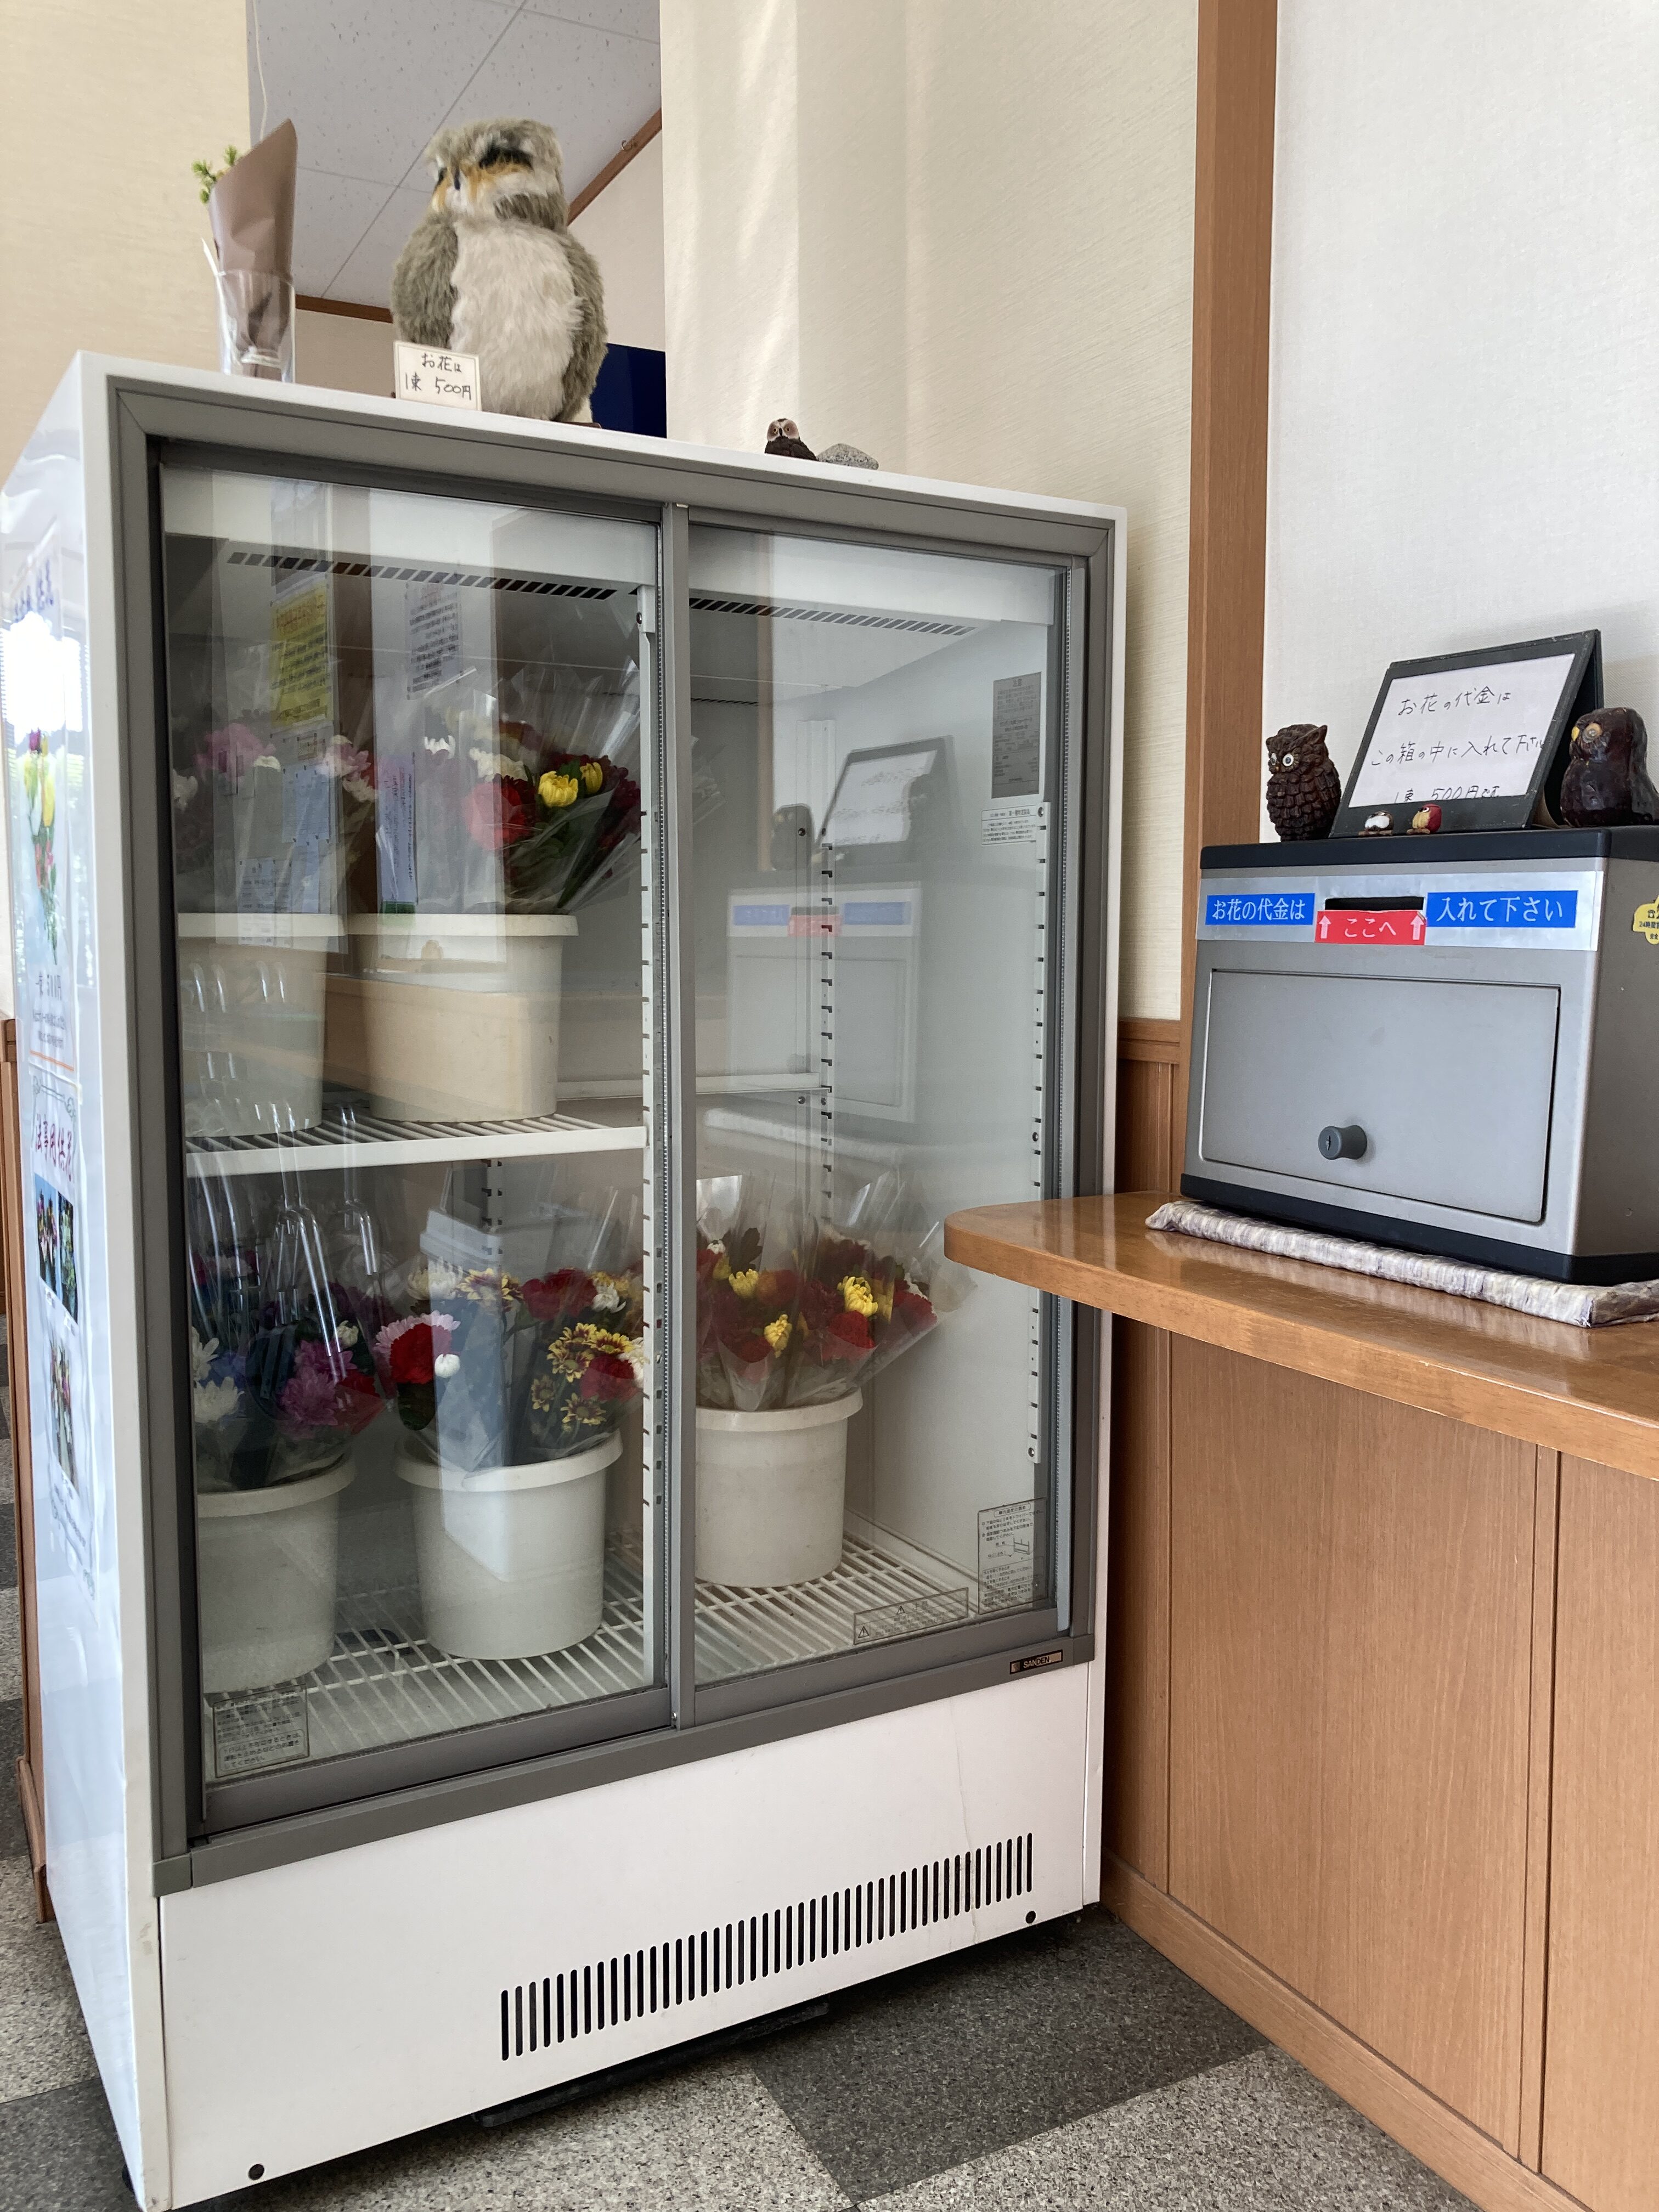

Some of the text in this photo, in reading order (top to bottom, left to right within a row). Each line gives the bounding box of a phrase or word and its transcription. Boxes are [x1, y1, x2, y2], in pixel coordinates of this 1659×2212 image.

[421, 353, 462, 373] お花は
[435, 377, 471, 400] 500円
[1398, 686, 1511, 716] お花の代金は
[1211, 895, 1564, 923] お花の代金は 入れて下さい
[1344, 917, 1397, 939] ここへ
[1023, 1655, 1050, 1668] SANDEN
